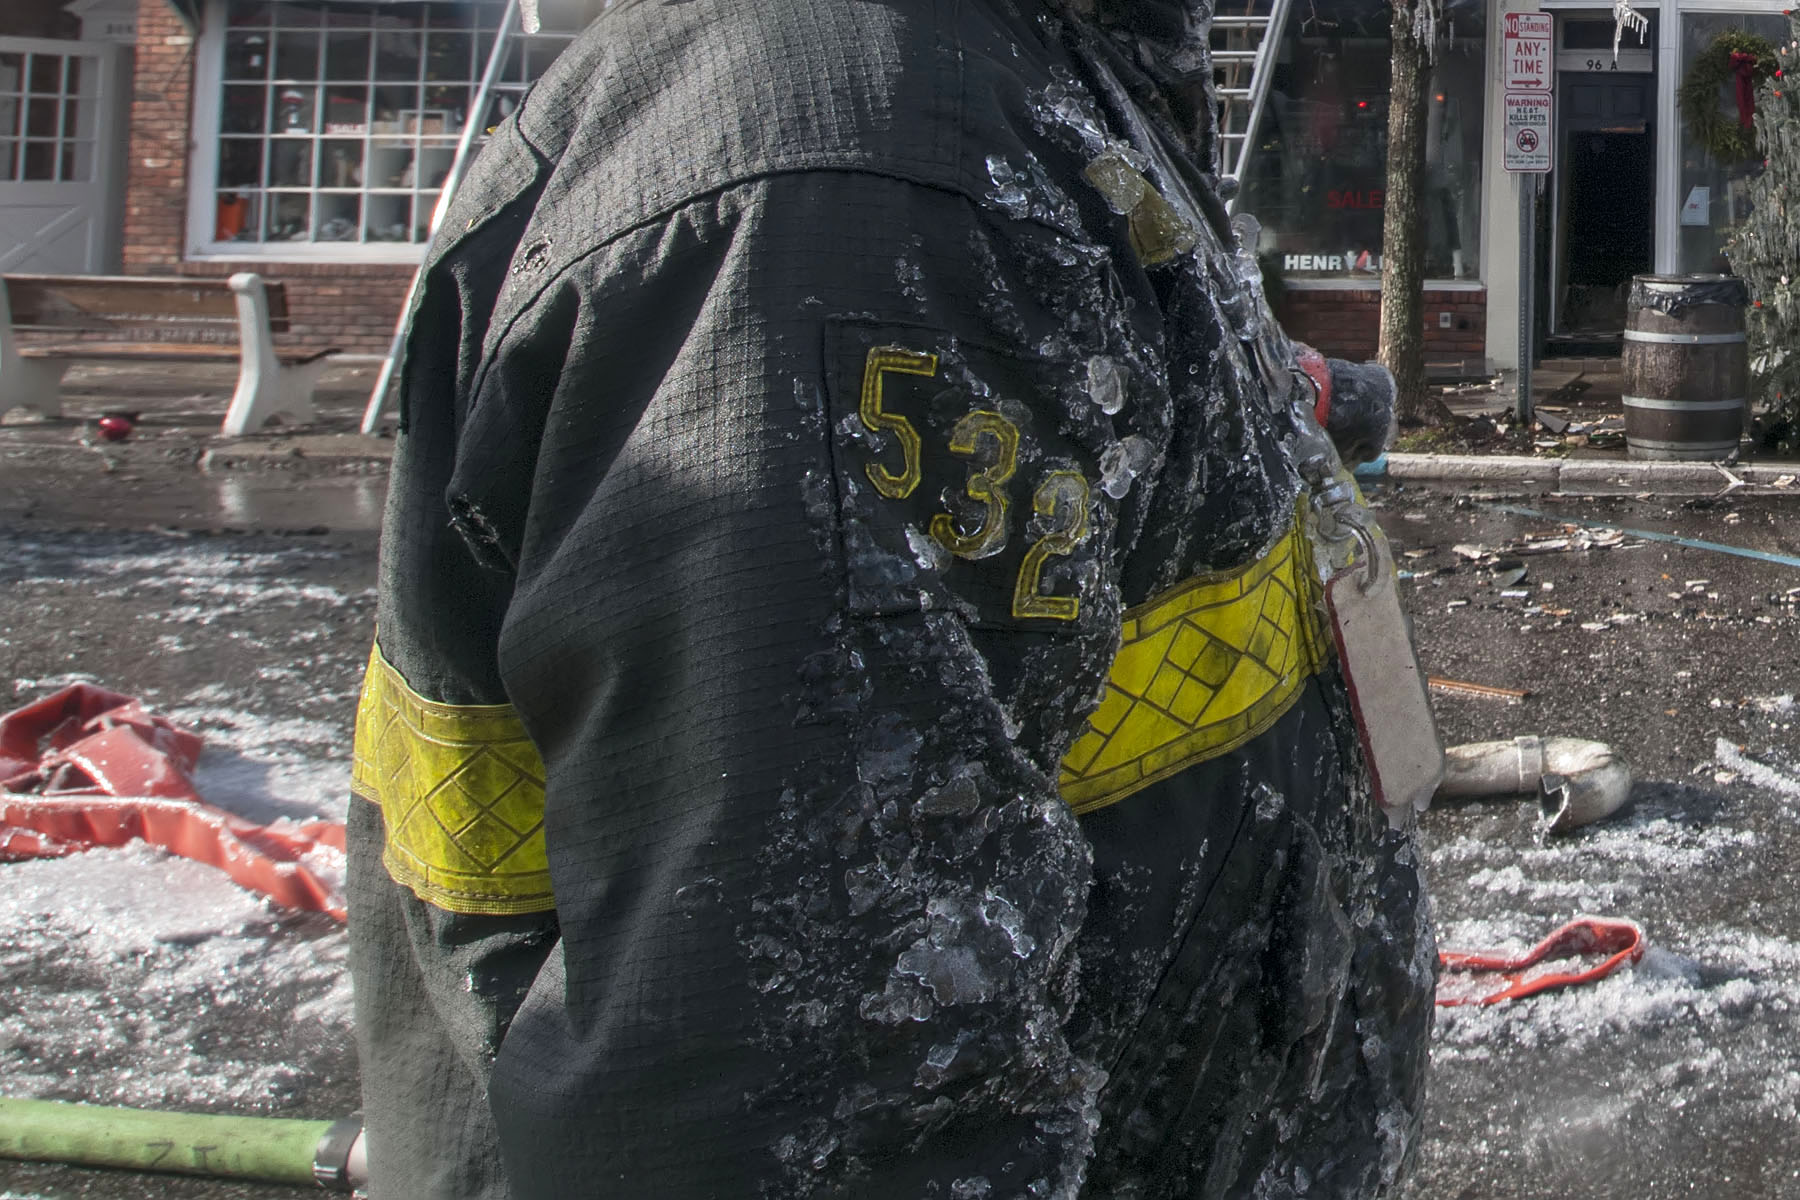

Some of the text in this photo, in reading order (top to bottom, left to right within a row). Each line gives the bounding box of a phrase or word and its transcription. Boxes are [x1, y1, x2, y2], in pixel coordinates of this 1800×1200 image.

[1505, 18, 1549, 34] NO STANDING
[1515, 41, 1540, 56] ANY
[1513, 59, 1543, 74] TIME
[1586, 59, 1602, 70] 96
[1507, 99, 1549, 107] WARNING
[1327, 190, 1383, 208] SALE
[860, 345, 1090, 620] 532
